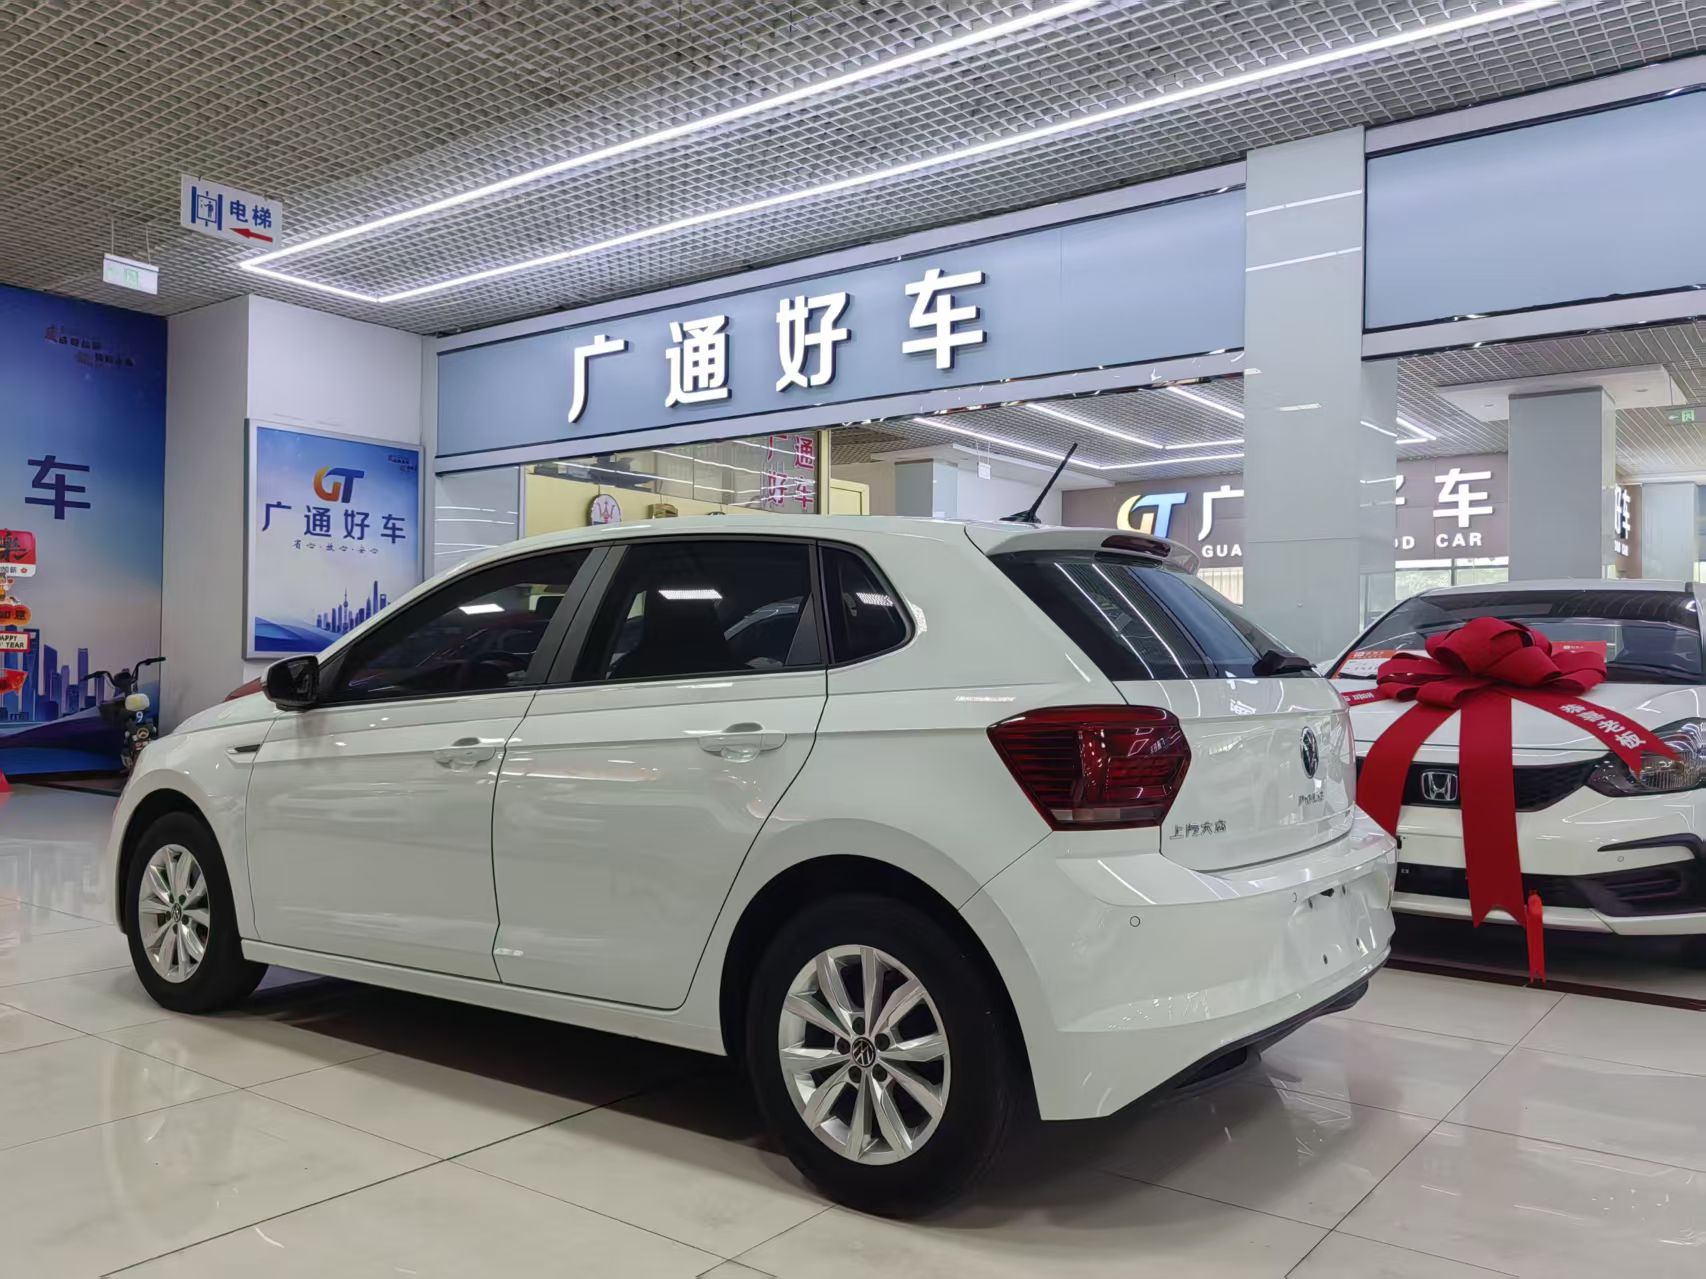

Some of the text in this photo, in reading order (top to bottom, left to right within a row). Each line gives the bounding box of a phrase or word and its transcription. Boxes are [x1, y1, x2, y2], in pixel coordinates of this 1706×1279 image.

[230, 199, 272, 229] 电梯
[567, 268, 987, 424] 广通好车
[25, 454, 91, 520] 车
[313, 465, 365, 504] GT
[261, 500, 406, 545] 广通好车
[1435, 532, 1483, 548] CAR
[135, 711, 144, 723] 9
